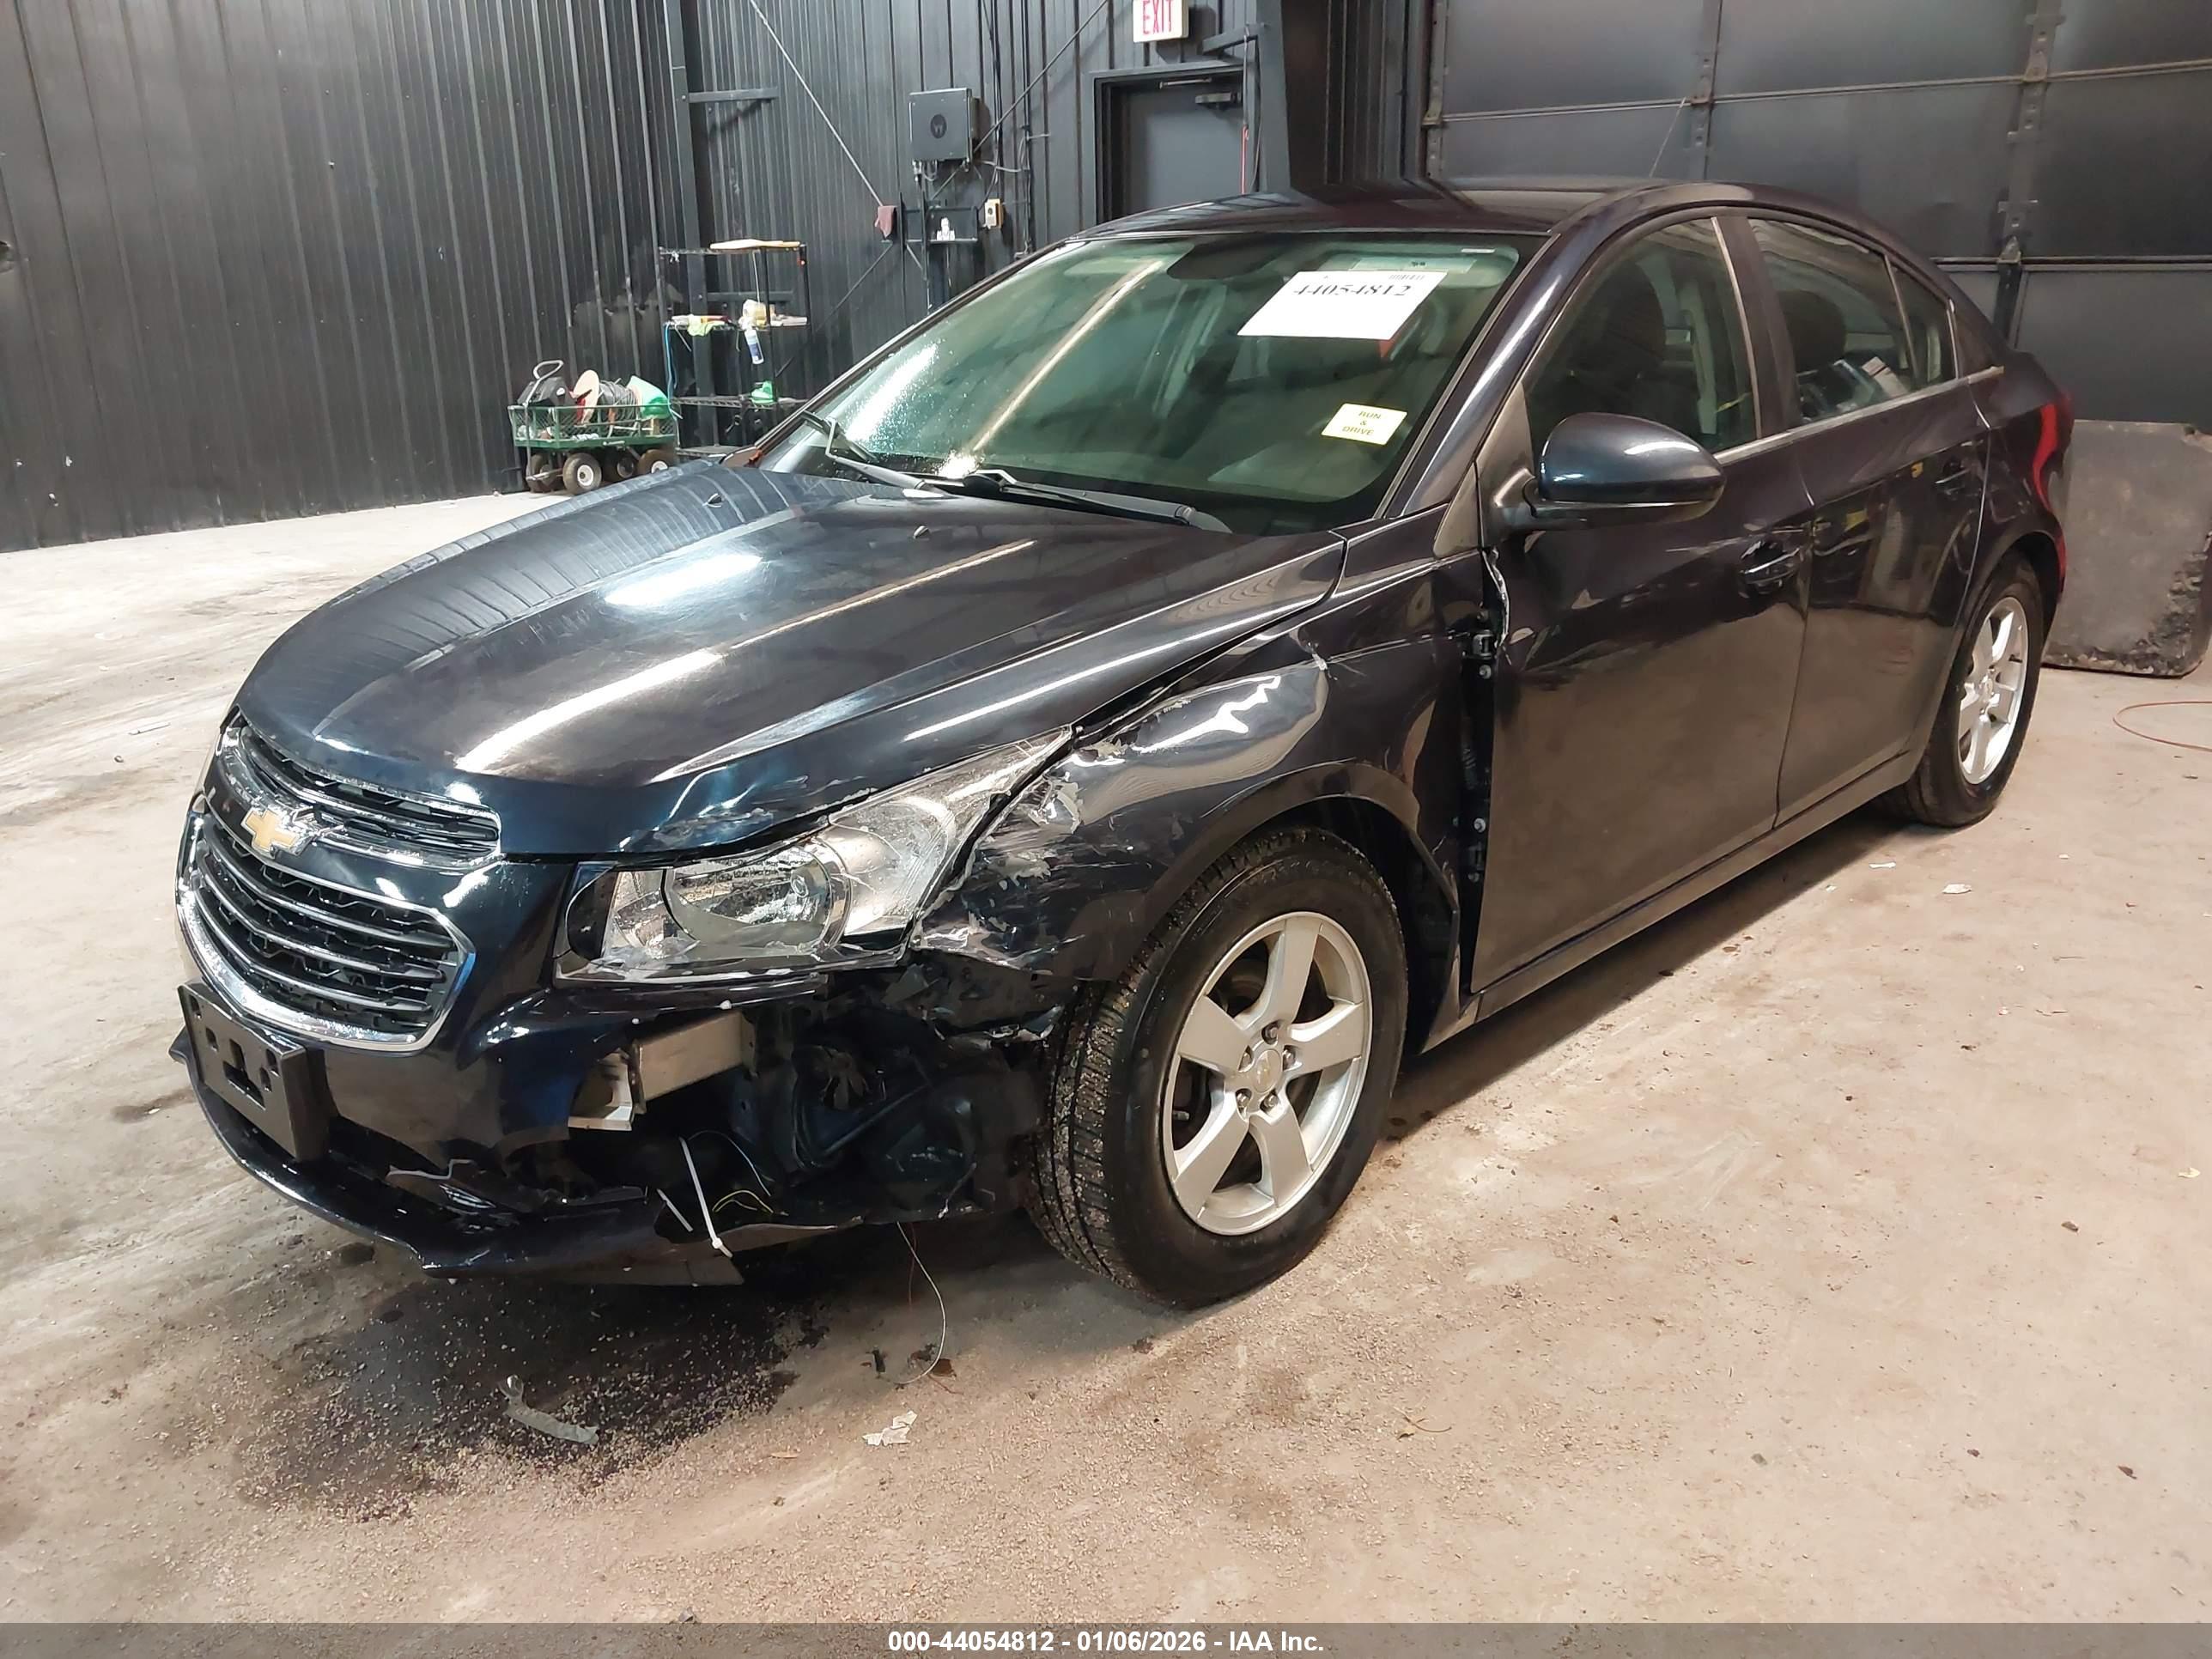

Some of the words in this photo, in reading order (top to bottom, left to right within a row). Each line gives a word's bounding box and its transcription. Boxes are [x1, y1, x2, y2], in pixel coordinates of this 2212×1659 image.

[1142, 0, 1173, 34] EXIT
[1293, 284, 1411, 296] 44054812
[1358, 410, 1382, 420] RUN
[1341, 426, 1375, 435] DRIVE
